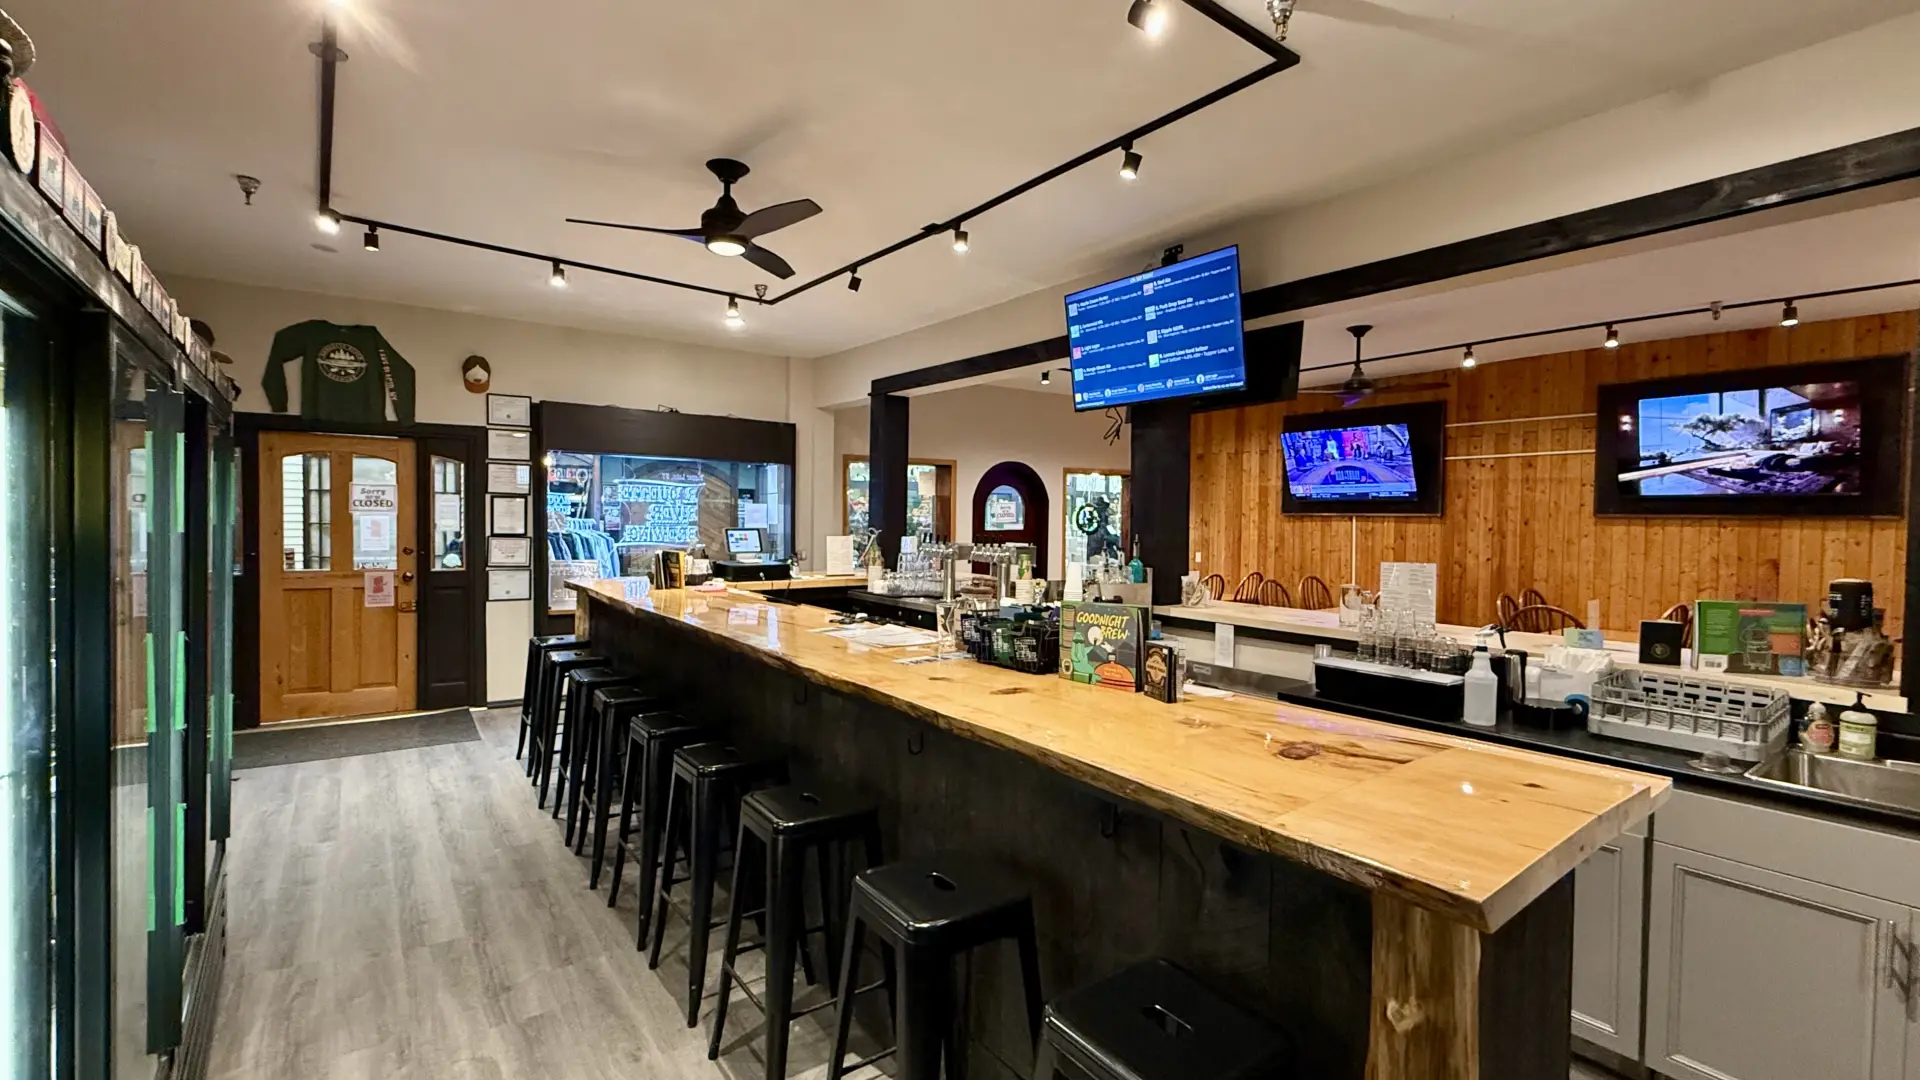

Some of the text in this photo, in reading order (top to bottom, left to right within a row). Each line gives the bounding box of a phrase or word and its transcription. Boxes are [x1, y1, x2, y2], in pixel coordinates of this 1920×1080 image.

[360, 488, 386, 496] Sorry
[352, 500, 393, 508] CLOSED
[1076, 611, 1130, 629] GOODNIGHT
[1100, 626, 1128, 640] BREW
